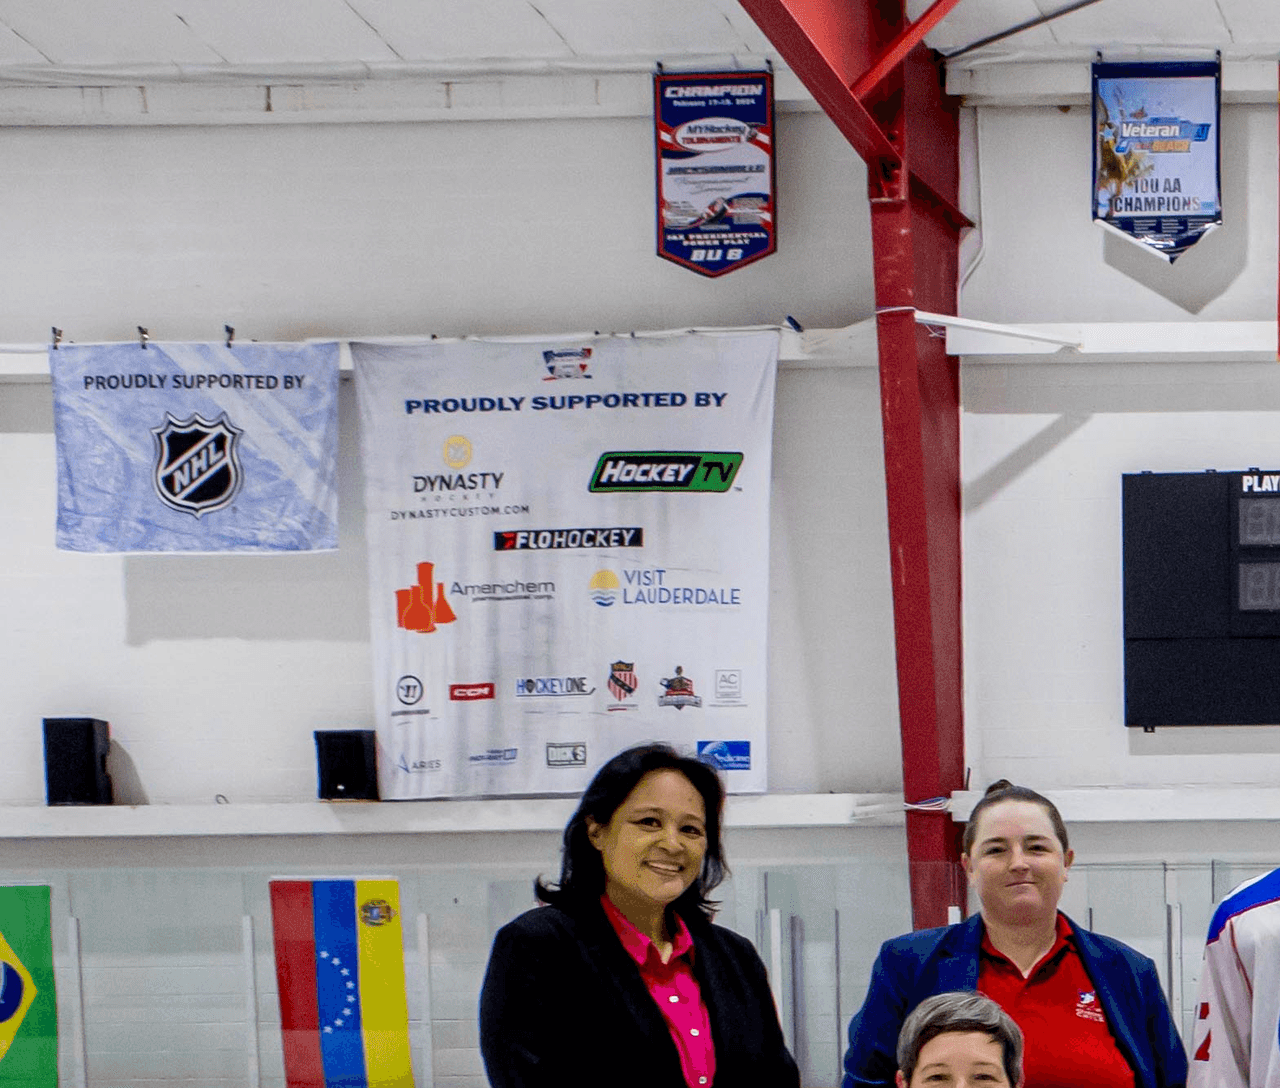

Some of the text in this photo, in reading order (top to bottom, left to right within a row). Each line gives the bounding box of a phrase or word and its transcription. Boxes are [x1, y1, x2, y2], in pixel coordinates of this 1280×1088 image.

[1122, 122, 1181, 138] Veteran
[1163, 178, 1182, 194] AA
[1114, 196, 1201, 213] CHAMPIONS
[83, 374, 306, 390] PROUDLY SUPPORTED BY
[405, 391, 729, 415] PROUDLY SUPPORTED BY
[172, 440, 225, 494] NHL
[412, 472, 505, 493] DYNASTY
[390, 505, 530, 521] DYNASTYCUSTOM.COM
[515, 529, 636, 550] FLOHOCKEY
[623, 569, 667, 587] VISIT
[450, 580, 556, 596] Americhem
[623, 586, 741, 606] LAUDERDALE
